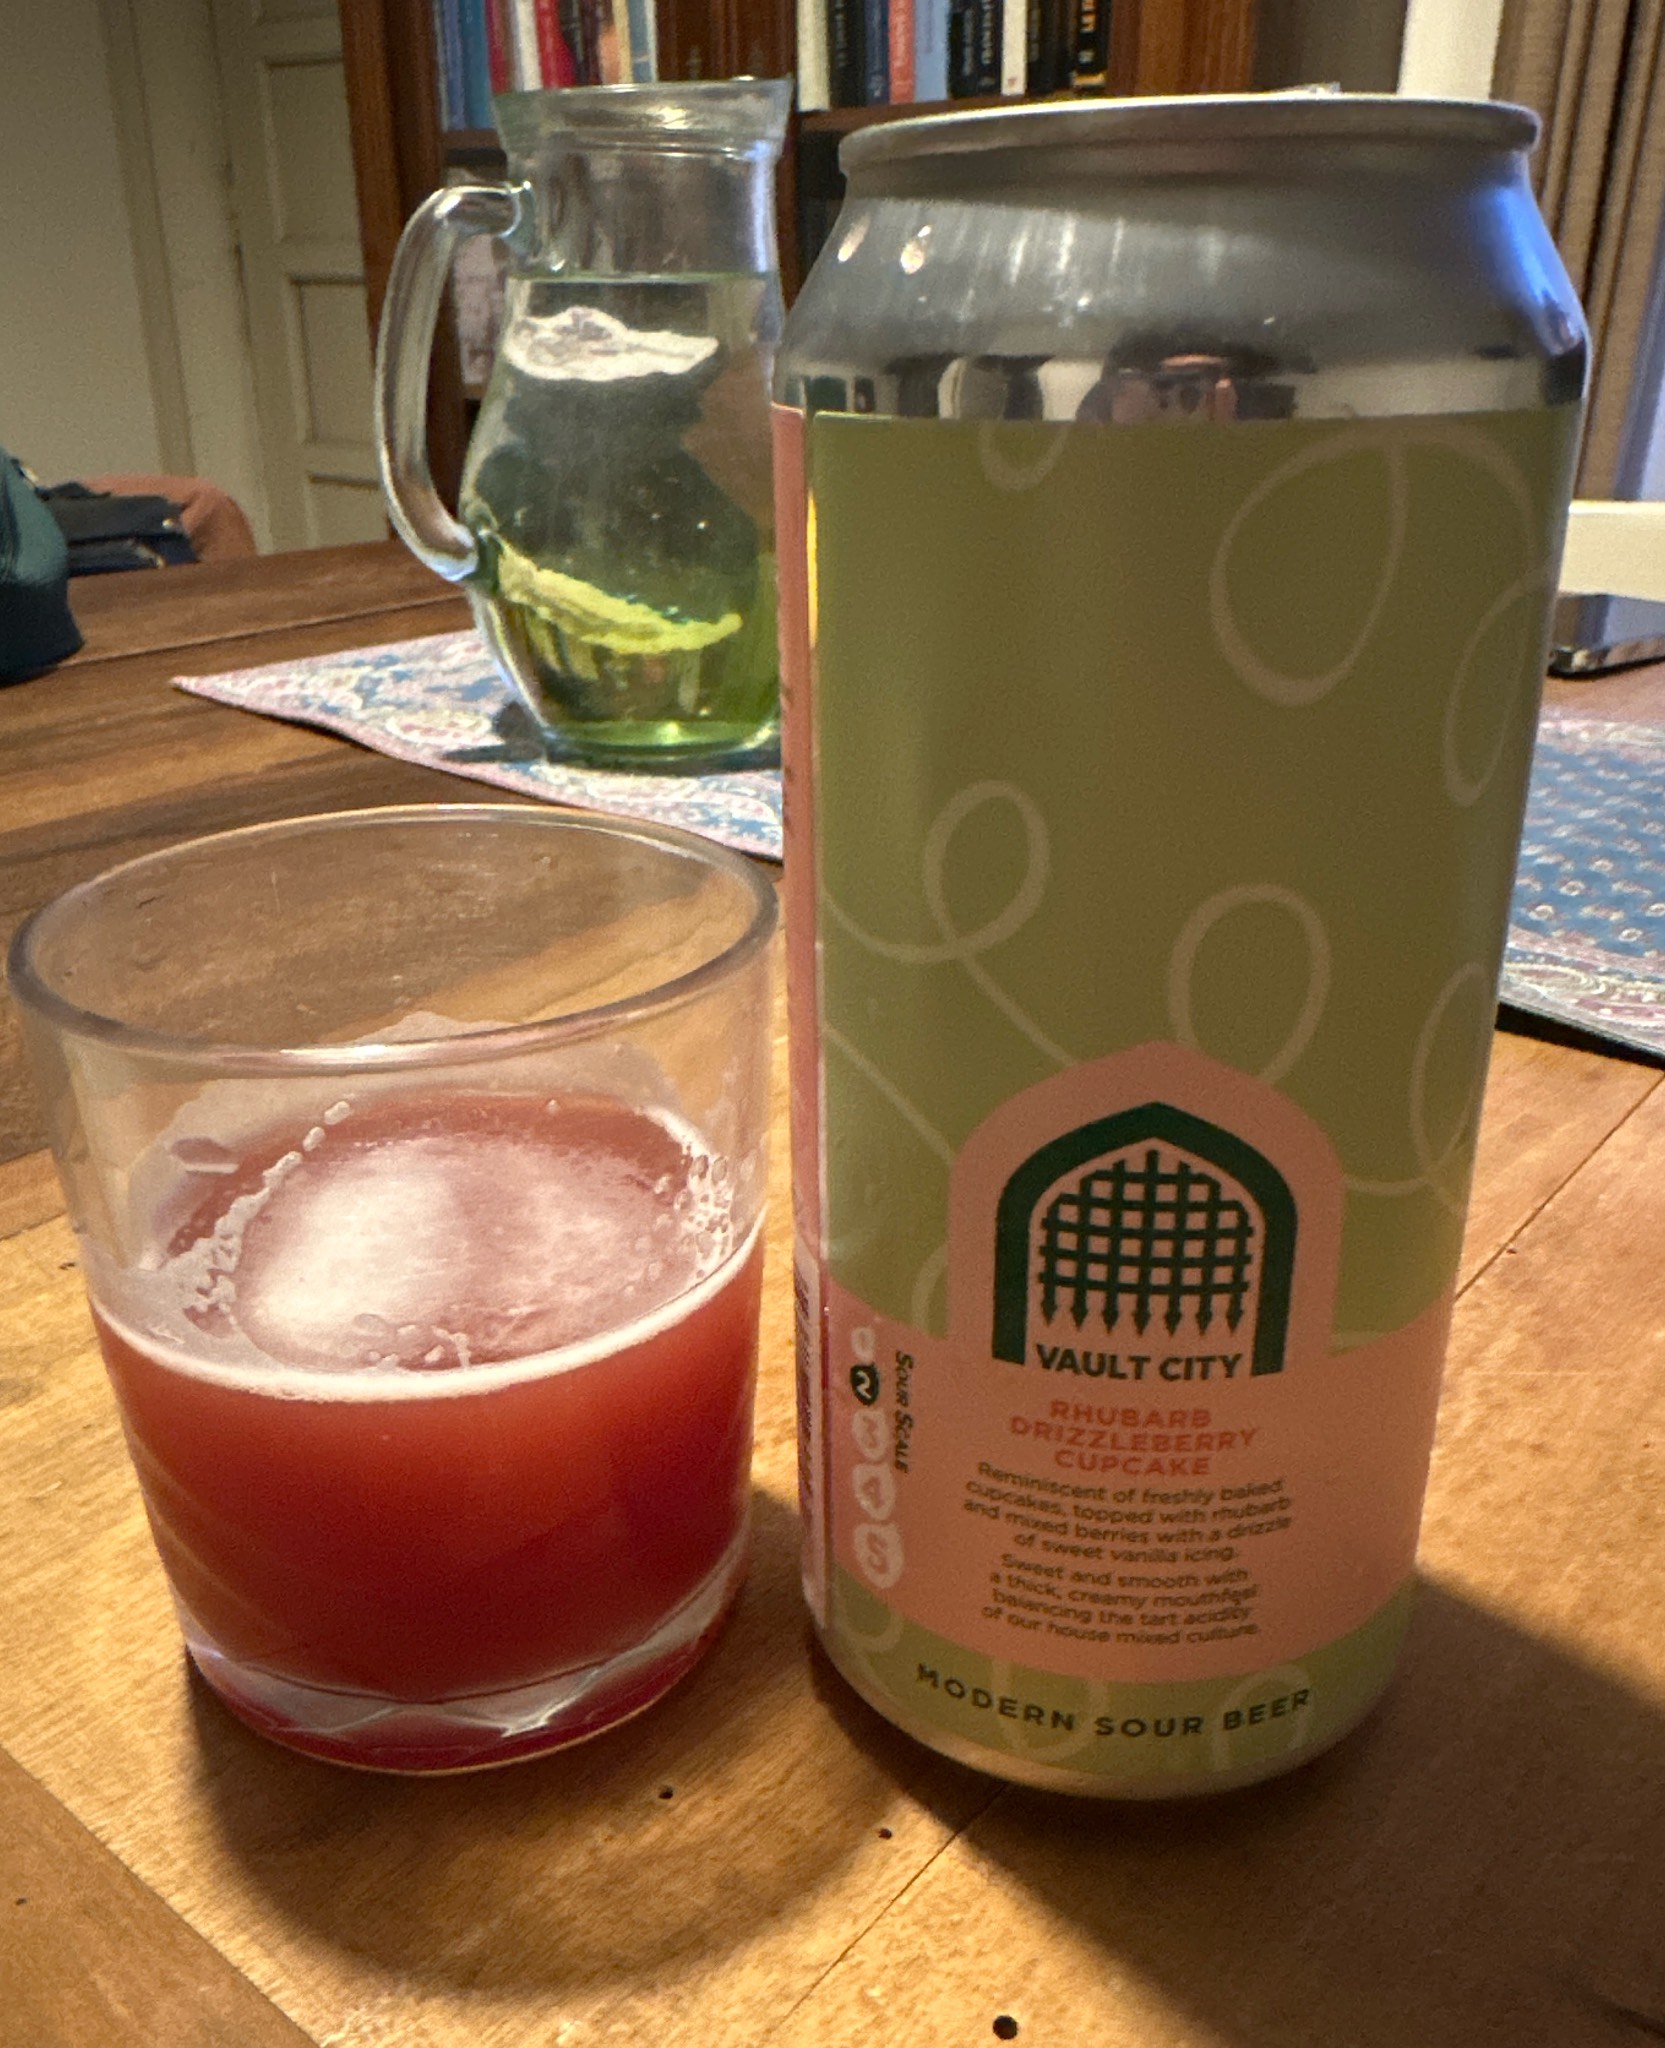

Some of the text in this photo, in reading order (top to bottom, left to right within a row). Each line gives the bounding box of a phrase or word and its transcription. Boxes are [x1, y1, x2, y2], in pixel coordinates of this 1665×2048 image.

[1036, 1344, 1242, 1382] VAULT CITY
[1050, 1401, 1212, 1428] RHUBARB
[1009, 1415, 1258, 1452] DRIZZLEBERRY
[1054, 1450, 1212, 1475] CUPCAKE
[977, 1461, 1284, 1506] Reminiscent of freshly baked
[963, 1499, 1000, 1520] and
[1004, 1512, 1069, 1536] mixed
[1074, 1522, 1150, 1544] berries
[1156, 1528, 1204, 1544] with
[1226, 1517, 1292, 1540] drizzle
[1073, 1504, 1154, 1525] topped
[1158, 1509, 1206, 1524] with
[1212, 1496, 1292, 1520] rhubarb
[1013, 1533, 1036, 1547] of
[1041, 1539, 1104, 1560] sweet
[1000, 1552, 1249, 1589] Sweet and smooth with
[1068, 1590, 1148, 1610] creamy
[1099, 1610, 1134, 1626] the
[1140, 1613, 1177, 1626] tart
[981, 1606, 1003, 1619] of
[1006, 1613, 1042, 1632] our
[1047, 1623, 1111, 1643] house
[1116, 1630, 1182, 1645] mixed
[916, 1662, 1311, 1738] MODERN SOUR BEER
